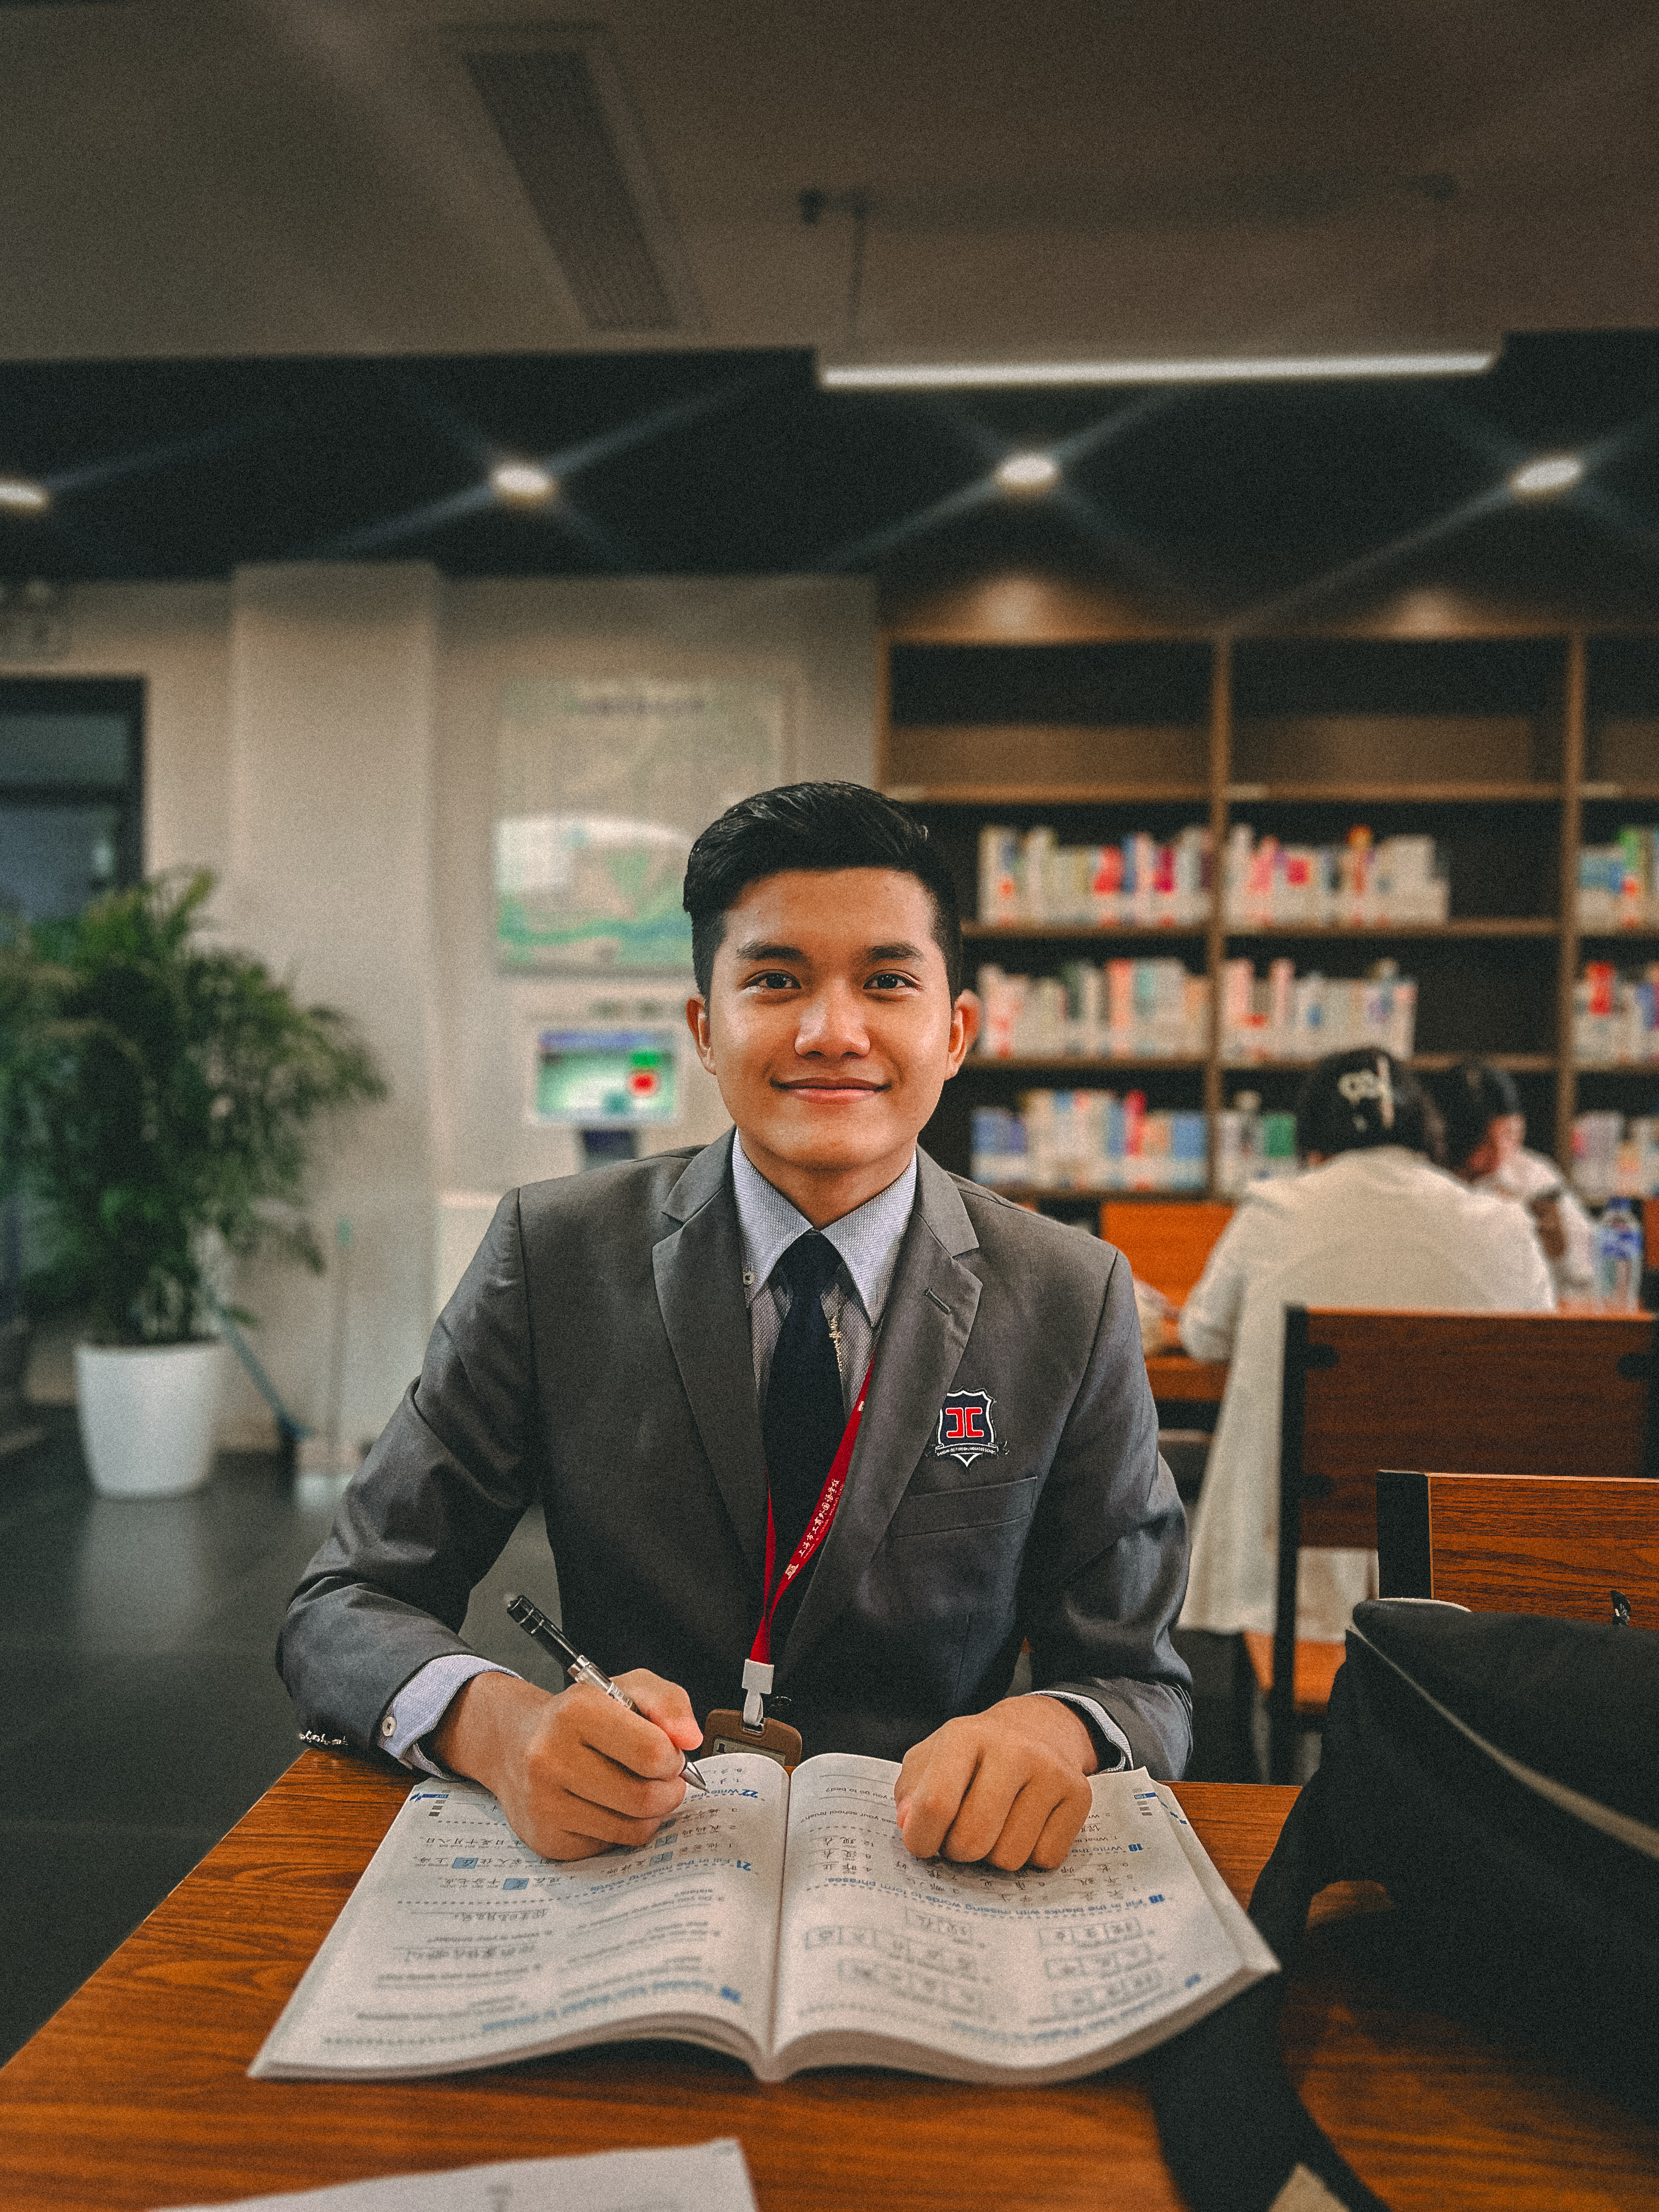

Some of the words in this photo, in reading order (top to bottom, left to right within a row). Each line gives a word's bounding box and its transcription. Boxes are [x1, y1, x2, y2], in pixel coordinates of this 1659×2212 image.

[742, 1788, 759, 1799] 22
[800, 1811, 827, 1824] finish?
[736, 1860, 751, 1872] 21
[629, 1865, 673, 1881] missing
[589, 1880, 624, 1892] words
[880, 1883, 907, 1895] form
[910, 1891, 922, 1899] to
[925, 1895, 962, 1909] words
[964, 1904, 1011, 1915] missing
[1044, 1907, 1084, 1915] blanks
